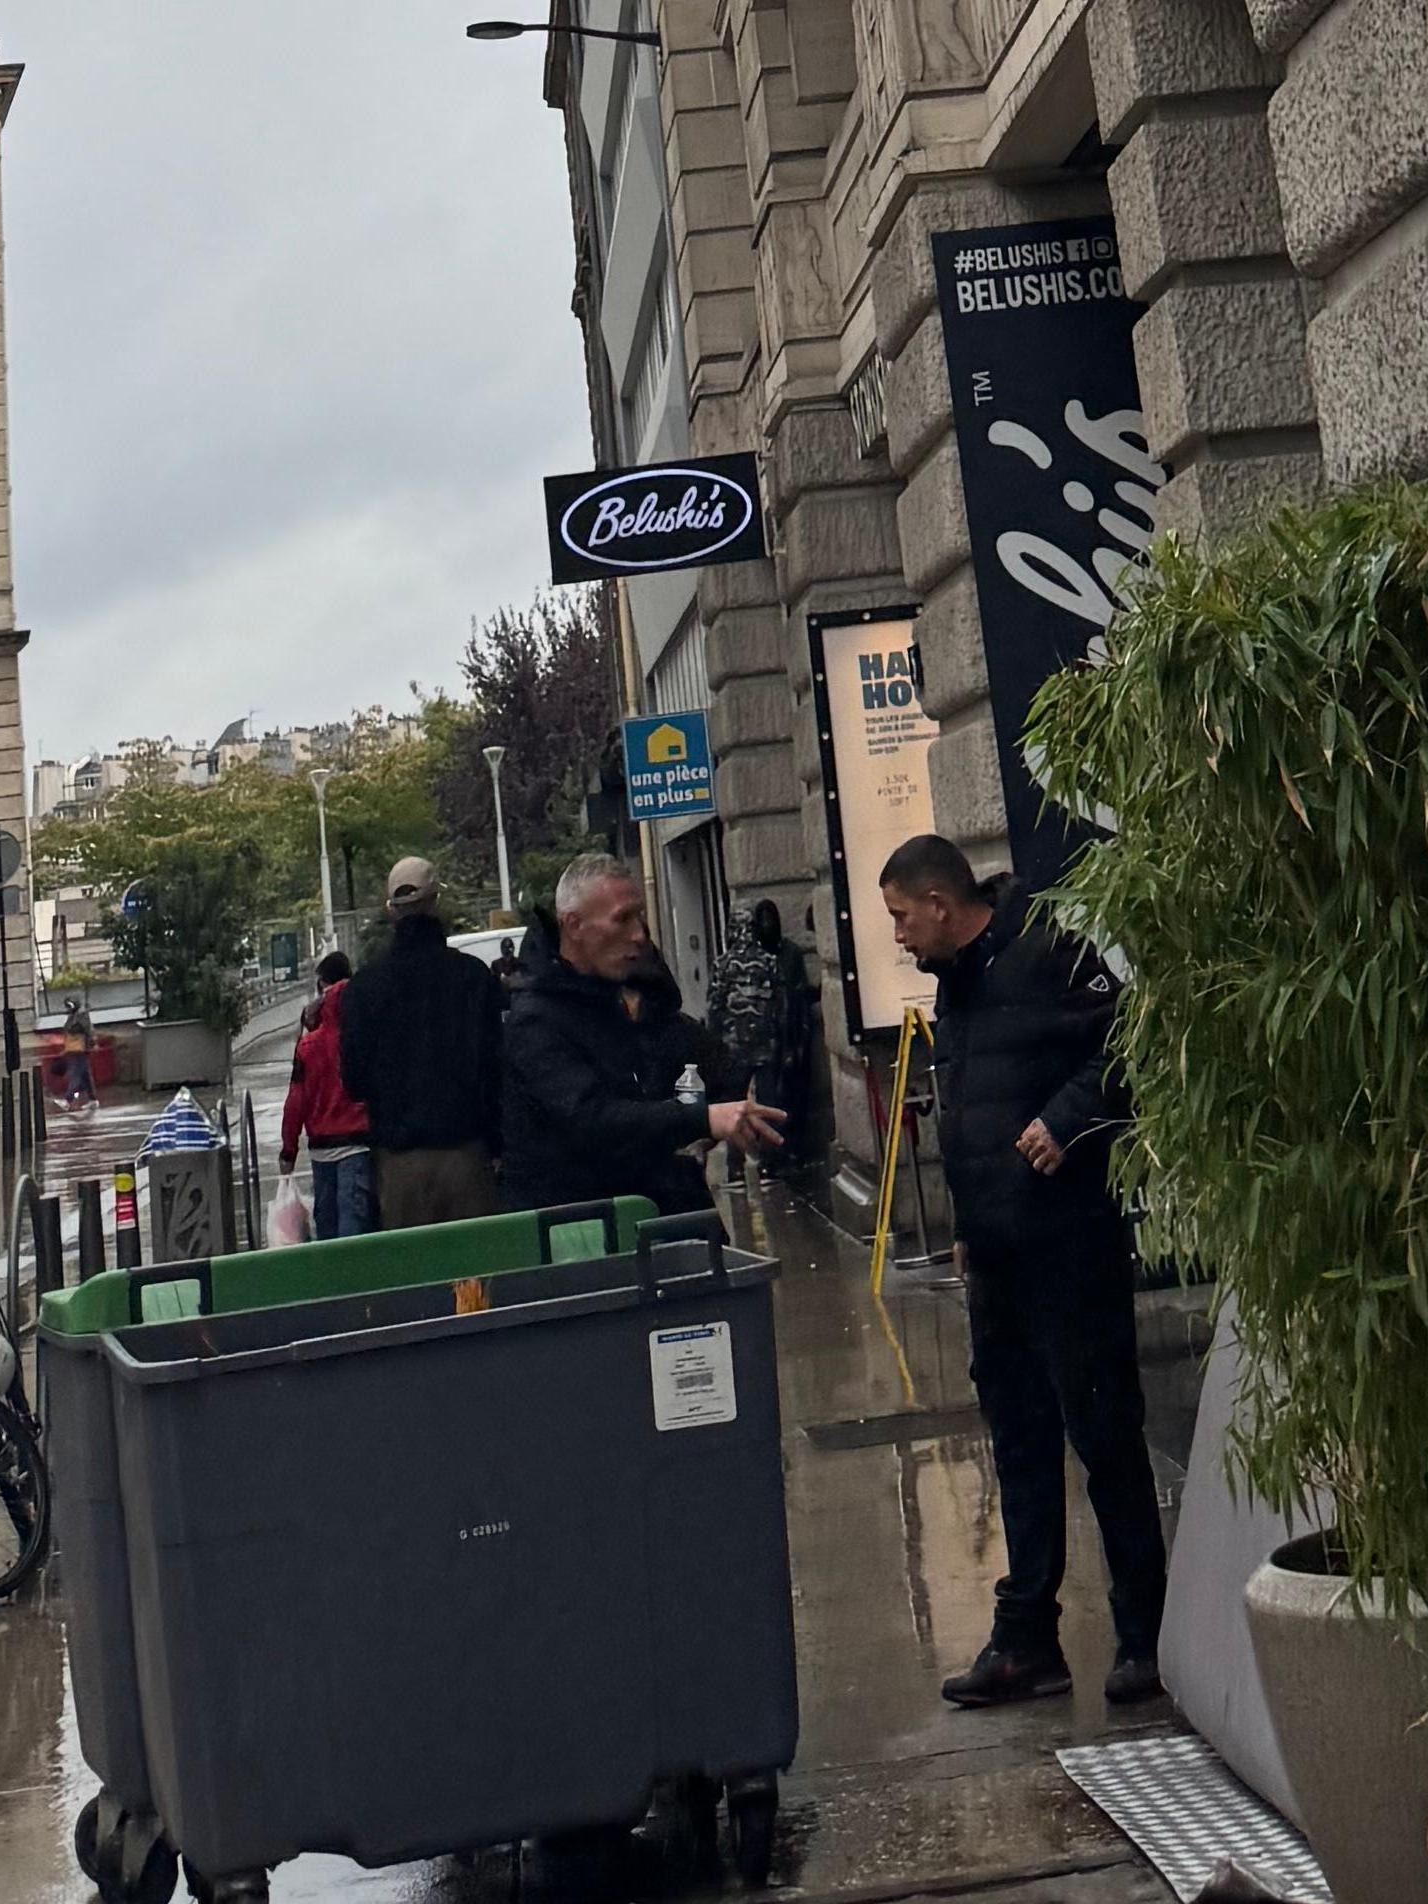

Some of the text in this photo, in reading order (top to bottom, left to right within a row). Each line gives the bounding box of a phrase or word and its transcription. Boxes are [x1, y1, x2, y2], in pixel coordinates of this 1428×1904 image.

[953, 242, 1064, 275] #BELUSHIS
[956, 266, 1124, 313] BELUSHIS.CO
[588, 484, 726, 547] Belushi's
[858, 651, 915, 681] HA
[861, 680, 916, 710] HO
[632, 765, 709, 787] une pièce
[633, 787, 694, 809] en plus
